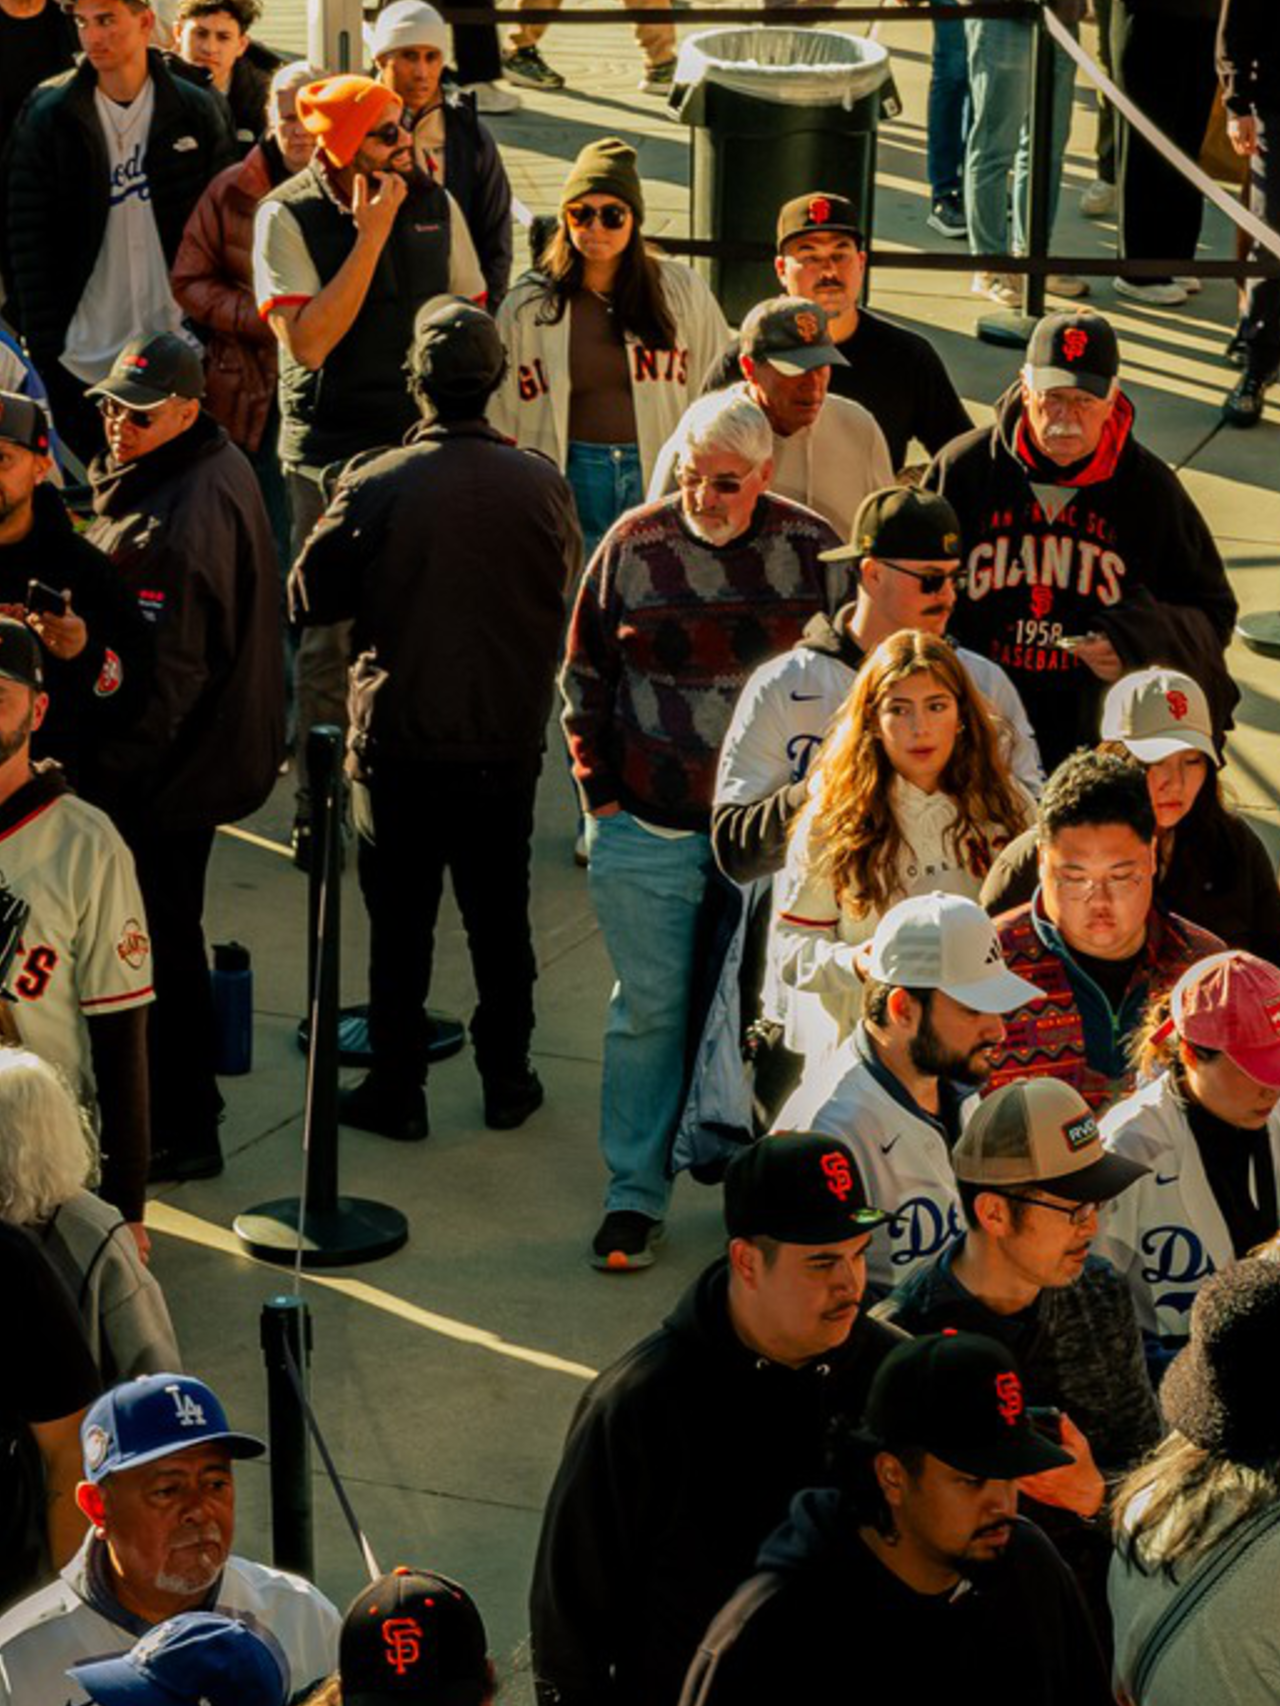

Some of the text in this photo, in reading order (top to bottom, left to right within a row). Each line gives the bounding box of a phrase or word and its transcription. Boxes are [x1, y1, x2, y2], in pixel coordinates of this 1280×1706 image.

[1061, 327, 1089, 363] SF
[967, 533, 1127, 608] GIANTS
[820, 1150, 853, 1202] SF
[164, 1384, 207, 1427] LA
[995, 1371, 1024, 1426] SF
[381, 1617, 425, 1673] SF
